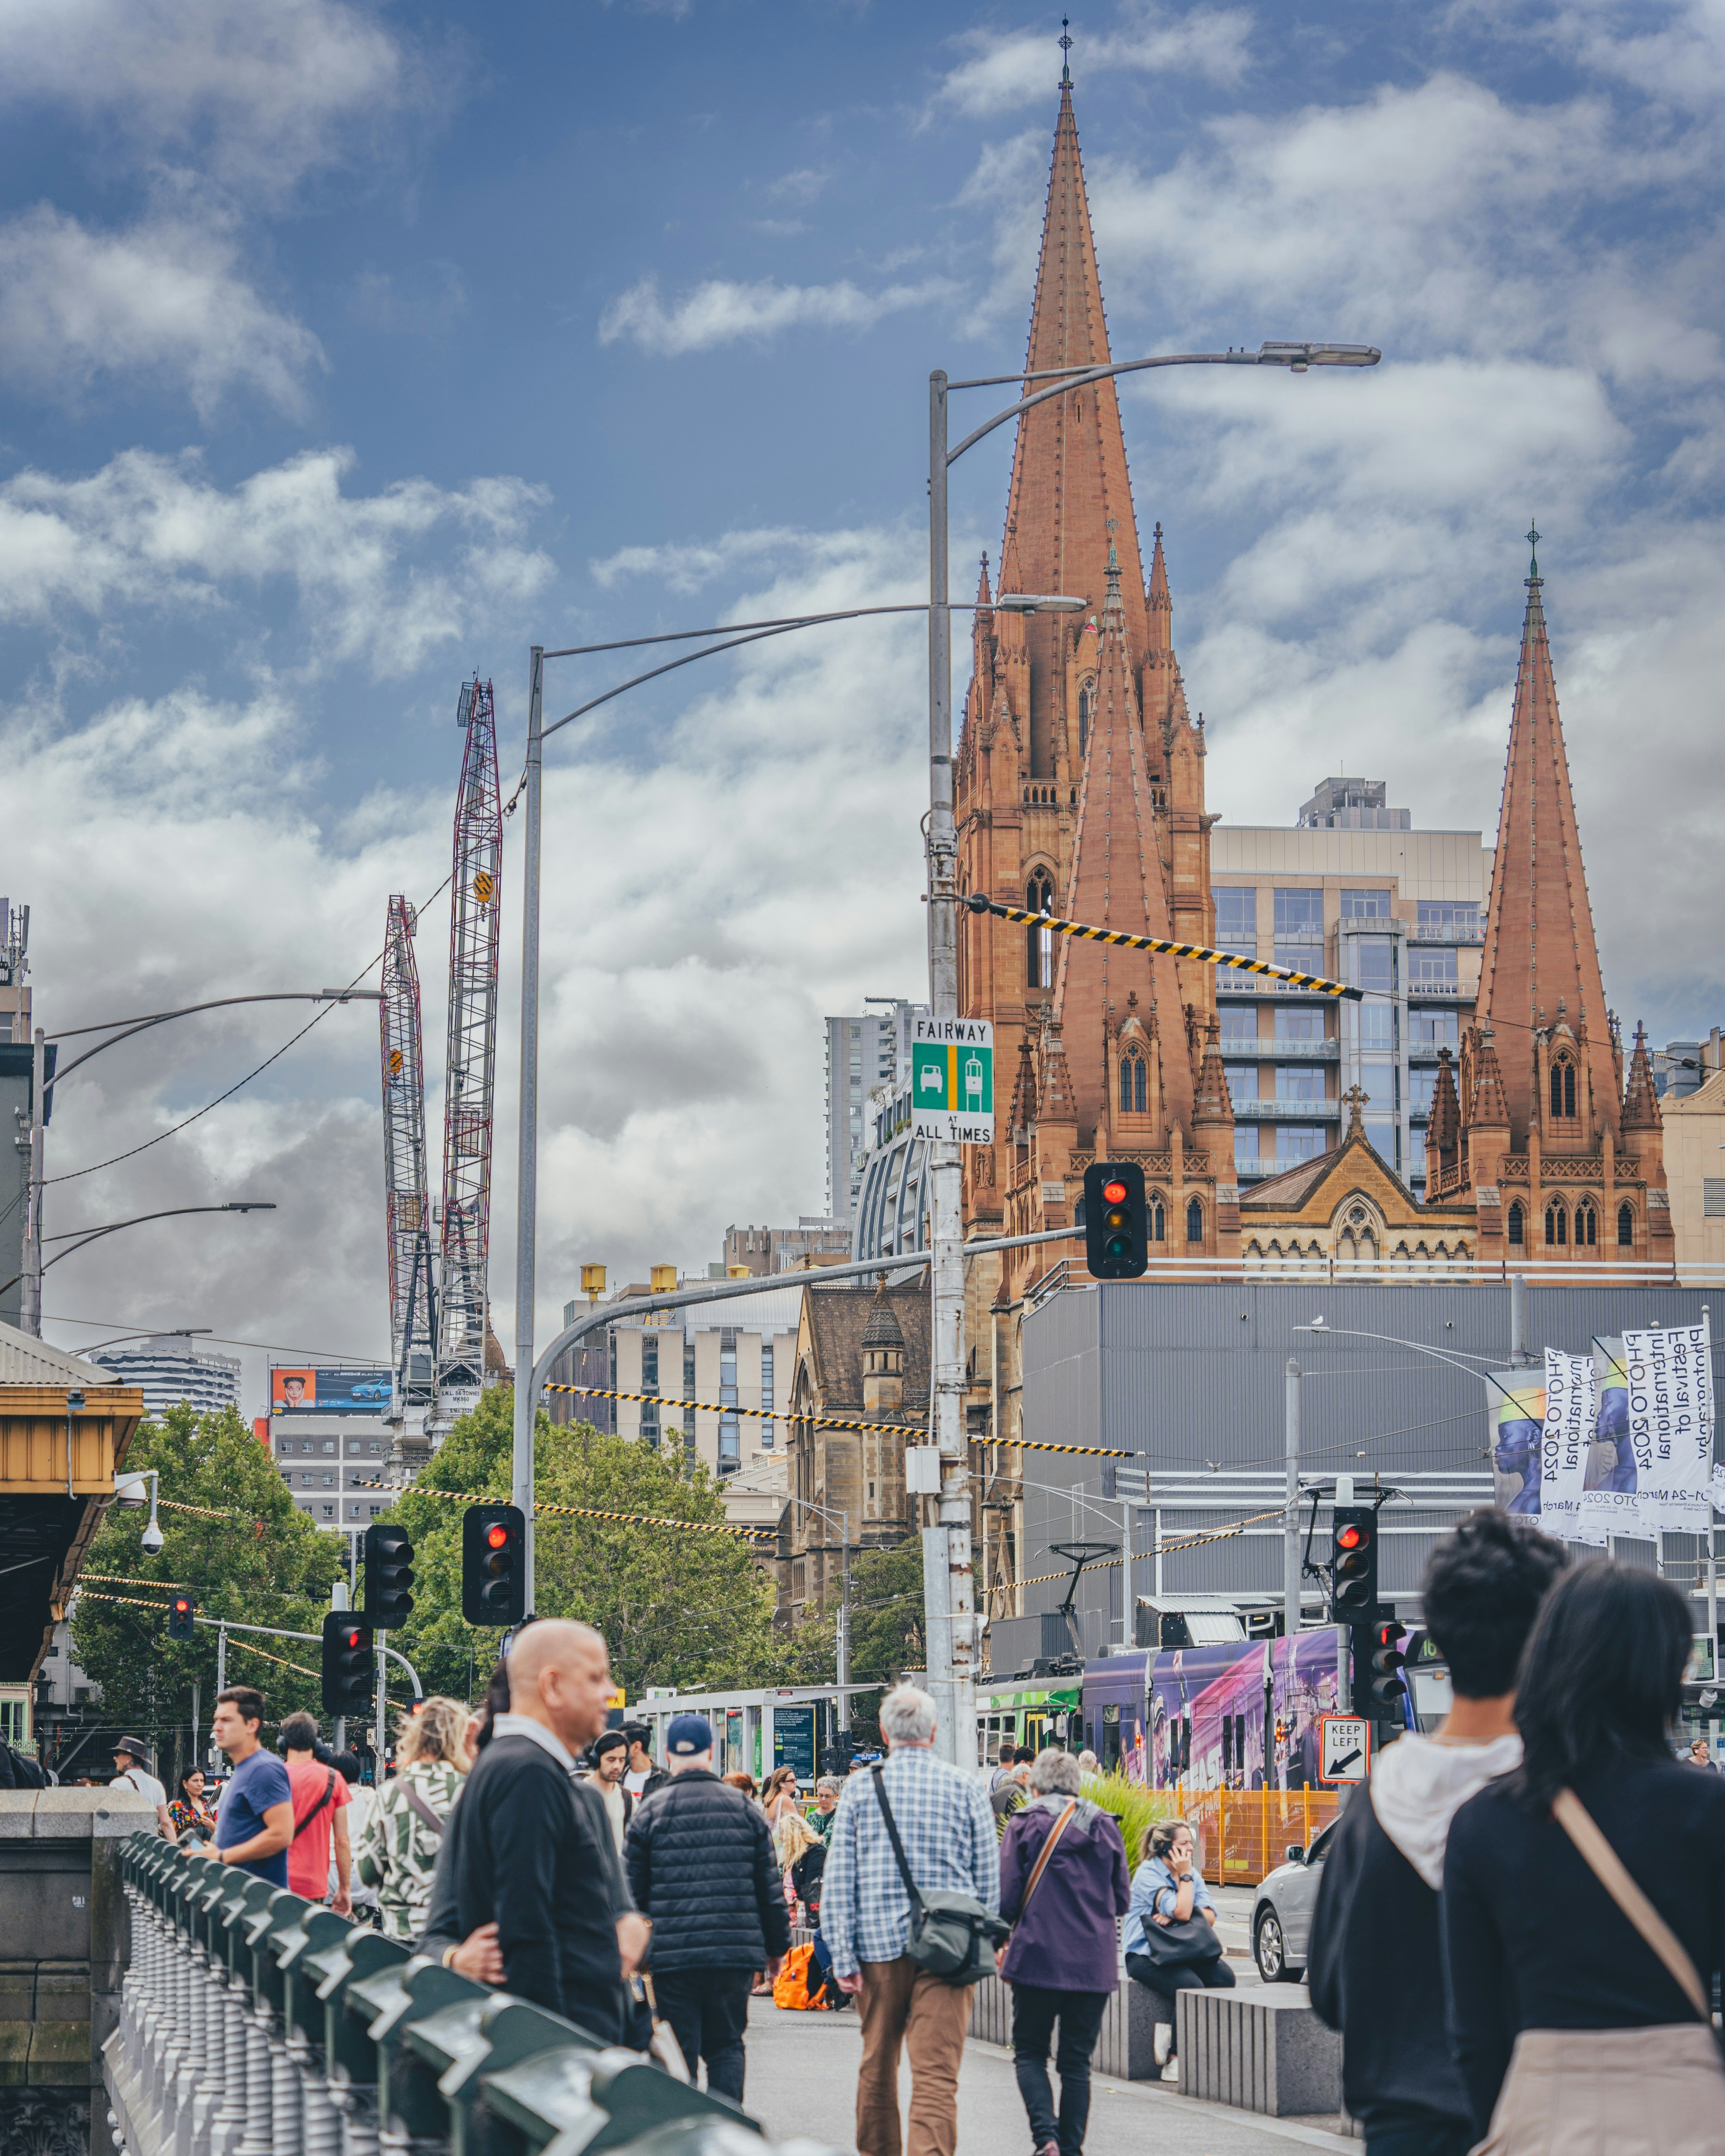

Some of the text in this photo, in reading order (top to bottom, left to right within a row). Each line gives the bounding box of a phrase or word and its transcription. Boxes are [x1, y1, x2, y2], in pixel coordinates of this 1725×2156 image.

[917, 1021, 986, 1041] FAIRWAY
[915, 1125, 990, 1142] ALL TIMES
[1424, 1639, 1437, 1656] 16
[1332, 1725, 1360, 1735] KEEP
[1333, 1738, 1358, 1746] LEFT
